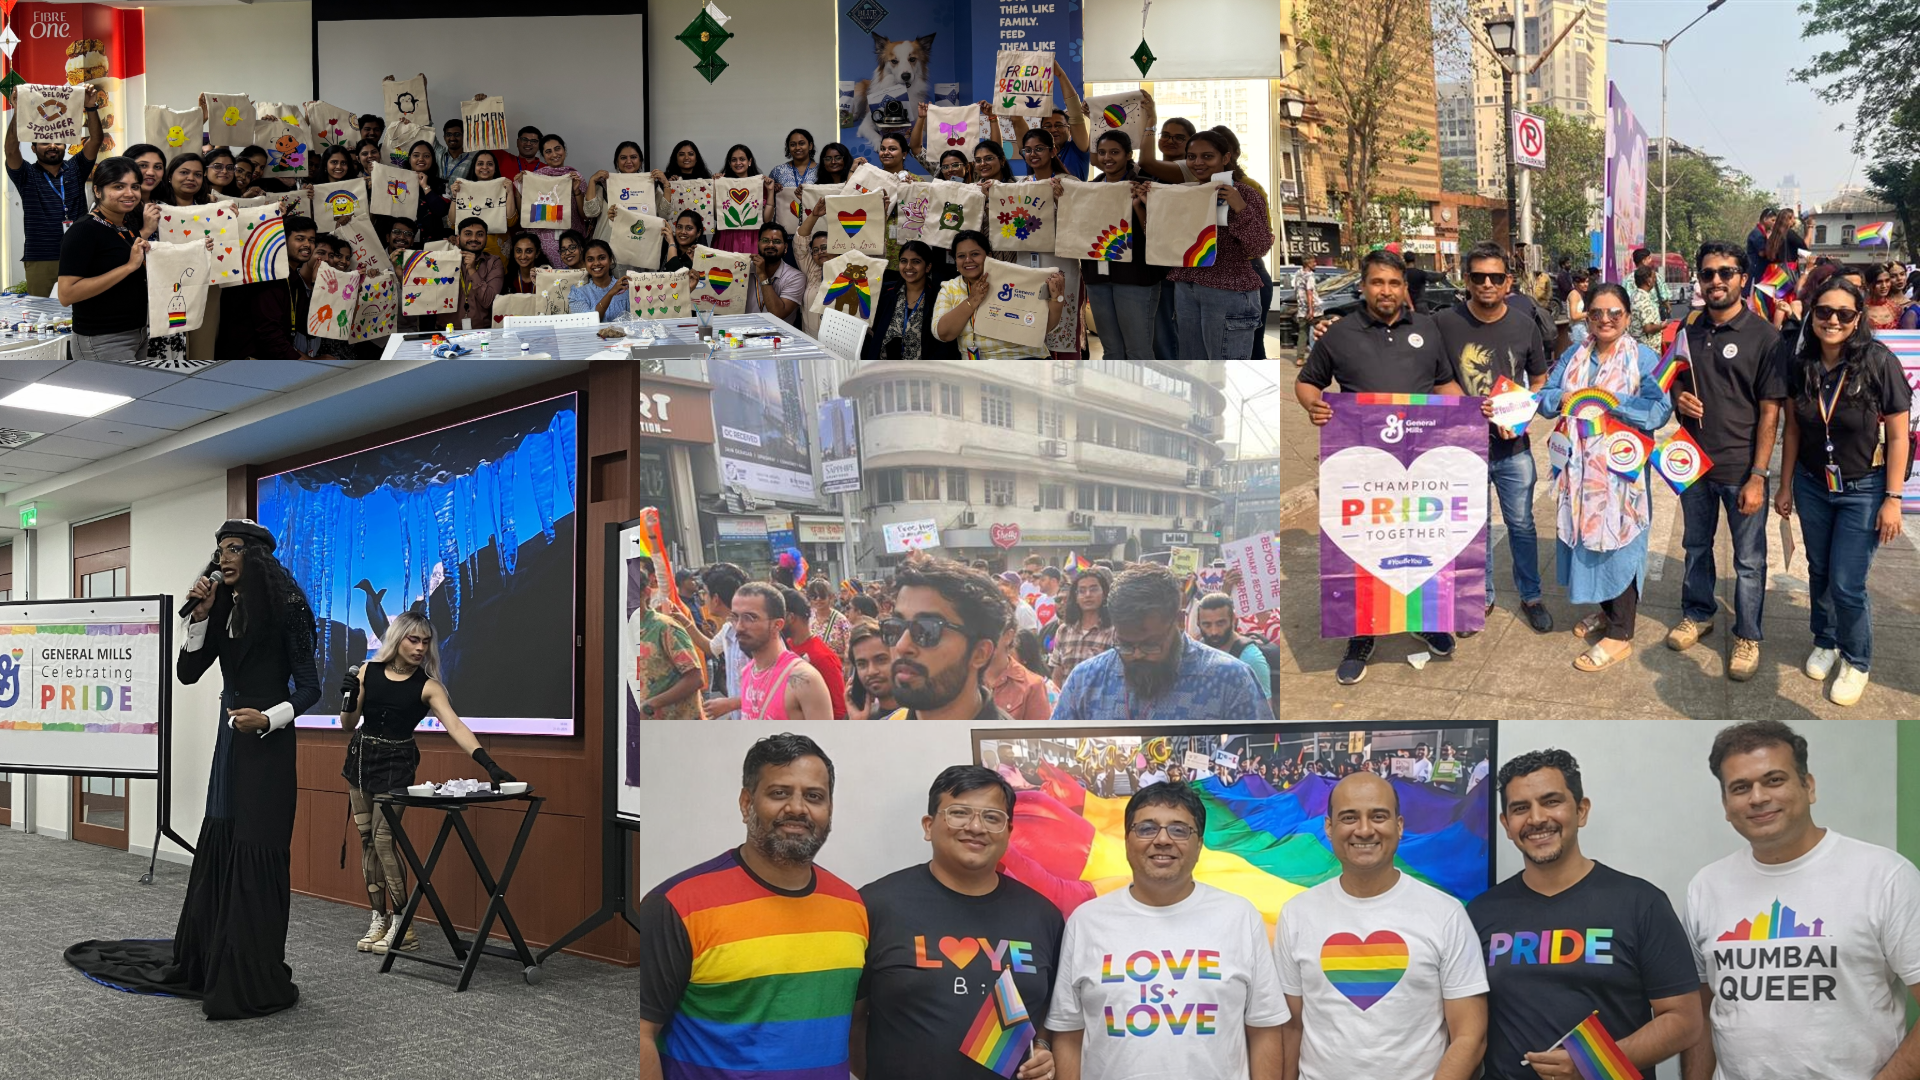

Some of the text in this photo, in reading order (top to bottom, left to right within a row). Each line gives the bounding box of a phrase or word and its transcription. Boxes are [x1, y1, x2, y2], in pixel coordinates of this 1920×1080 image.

[1000, 4, 1055, 14] THEM LIKE
[33, 11, 67, 22] FIBRE
[1000, 17, 1039, 27] FAMILY.
[29, 22, 70, 39] One
[1000, 30, 1026, 39] FEED
[1000, 41, 1056, 51] THEM LIKE
[1005, 65, 1052, 79] FREEDOM
[42, 91, 70, 100] BELONG
[27, 118, 74, 132] STRONGER
[466, 112, 504, 124] HUMAN
[34, 129, 76, 140] TOGETHER
[1000, 195, 1046, 210] PRIDE!
[1405, 419, 1436, 427] General
[733, 431, 759, 444] RECEIVED
[1363, 481, 1449, 492] CHAMPION
[1341, 496, 1468, 526] PRIDE
[1366, 528, 1446, 541] TOGETHER
[1261, 536, 1276, 576] BEYOND
[1387, 558, 1423, 566] #YouBeYou
[1252, 579, 1265, 611] BEYOND
[42, 648, 132, 660] GENERAL MILLS
[41, 665, 132, 682] Celebrating
[41, 684, 132, 711] PRIDE
[1488, 928, 1613, 967] PRIDE
[1713, 945, 1837, 971] MUMBAI
[1101, 949, 1221, 984] LOVE
[1140, 983, 1164, 1003] IS
[1719, 975, 1837, 1002] QUEER
[1104, 1003, 1218, 1037] LOVE
